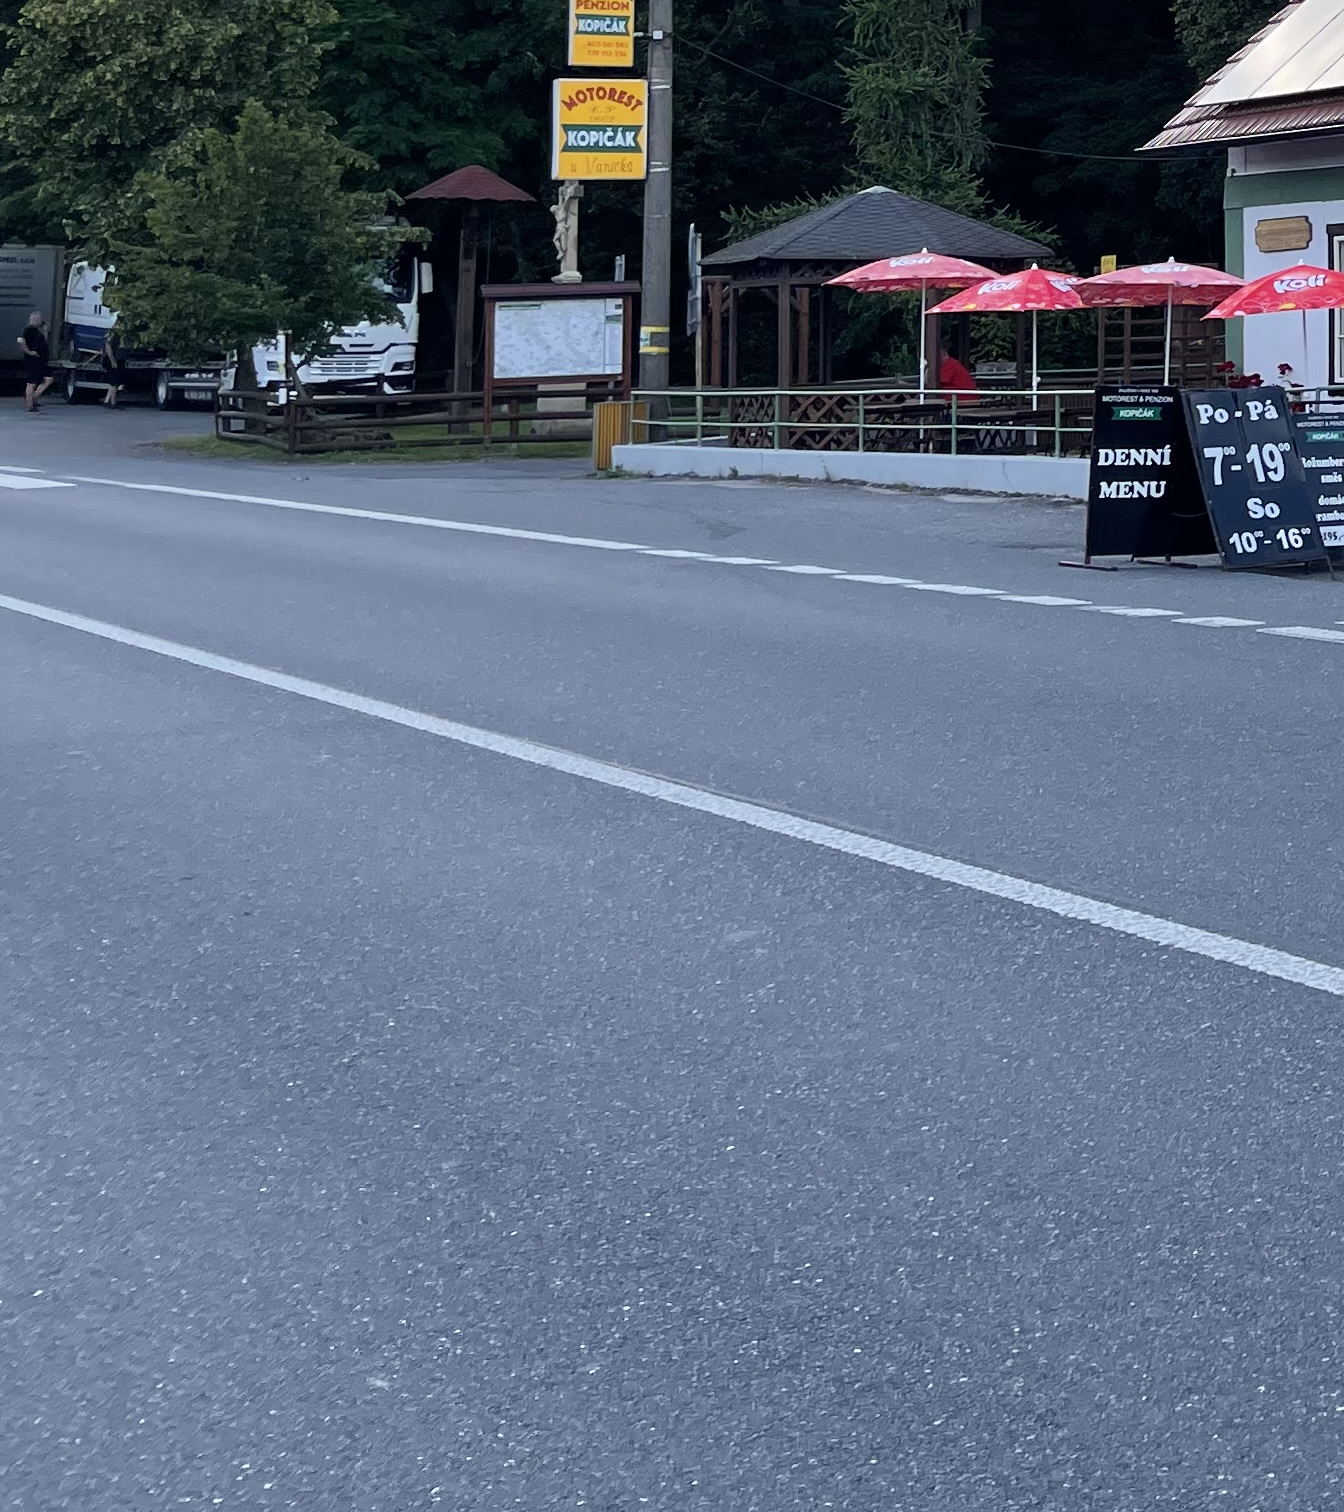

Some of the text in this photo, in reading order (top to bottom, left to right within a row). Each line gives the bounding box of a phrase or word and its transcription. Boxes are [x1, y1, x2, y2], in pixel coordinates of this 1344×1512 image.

[575, 0, 630, 12] PENZION
[578, 16, 627, 33] KOPIČÁK
[561, 86, 643, 112] MOTOREST
[567, 126, 636, 147] KOPIČÁK
[1195, 403, 1230, 425] Po
[1245, 399, 1279, 421] Pá
[1097, 444, 1172, 466] DENNÍ
[1098, 480, 1167, 499] MENU
[1246, 497, 1281, 519] So
